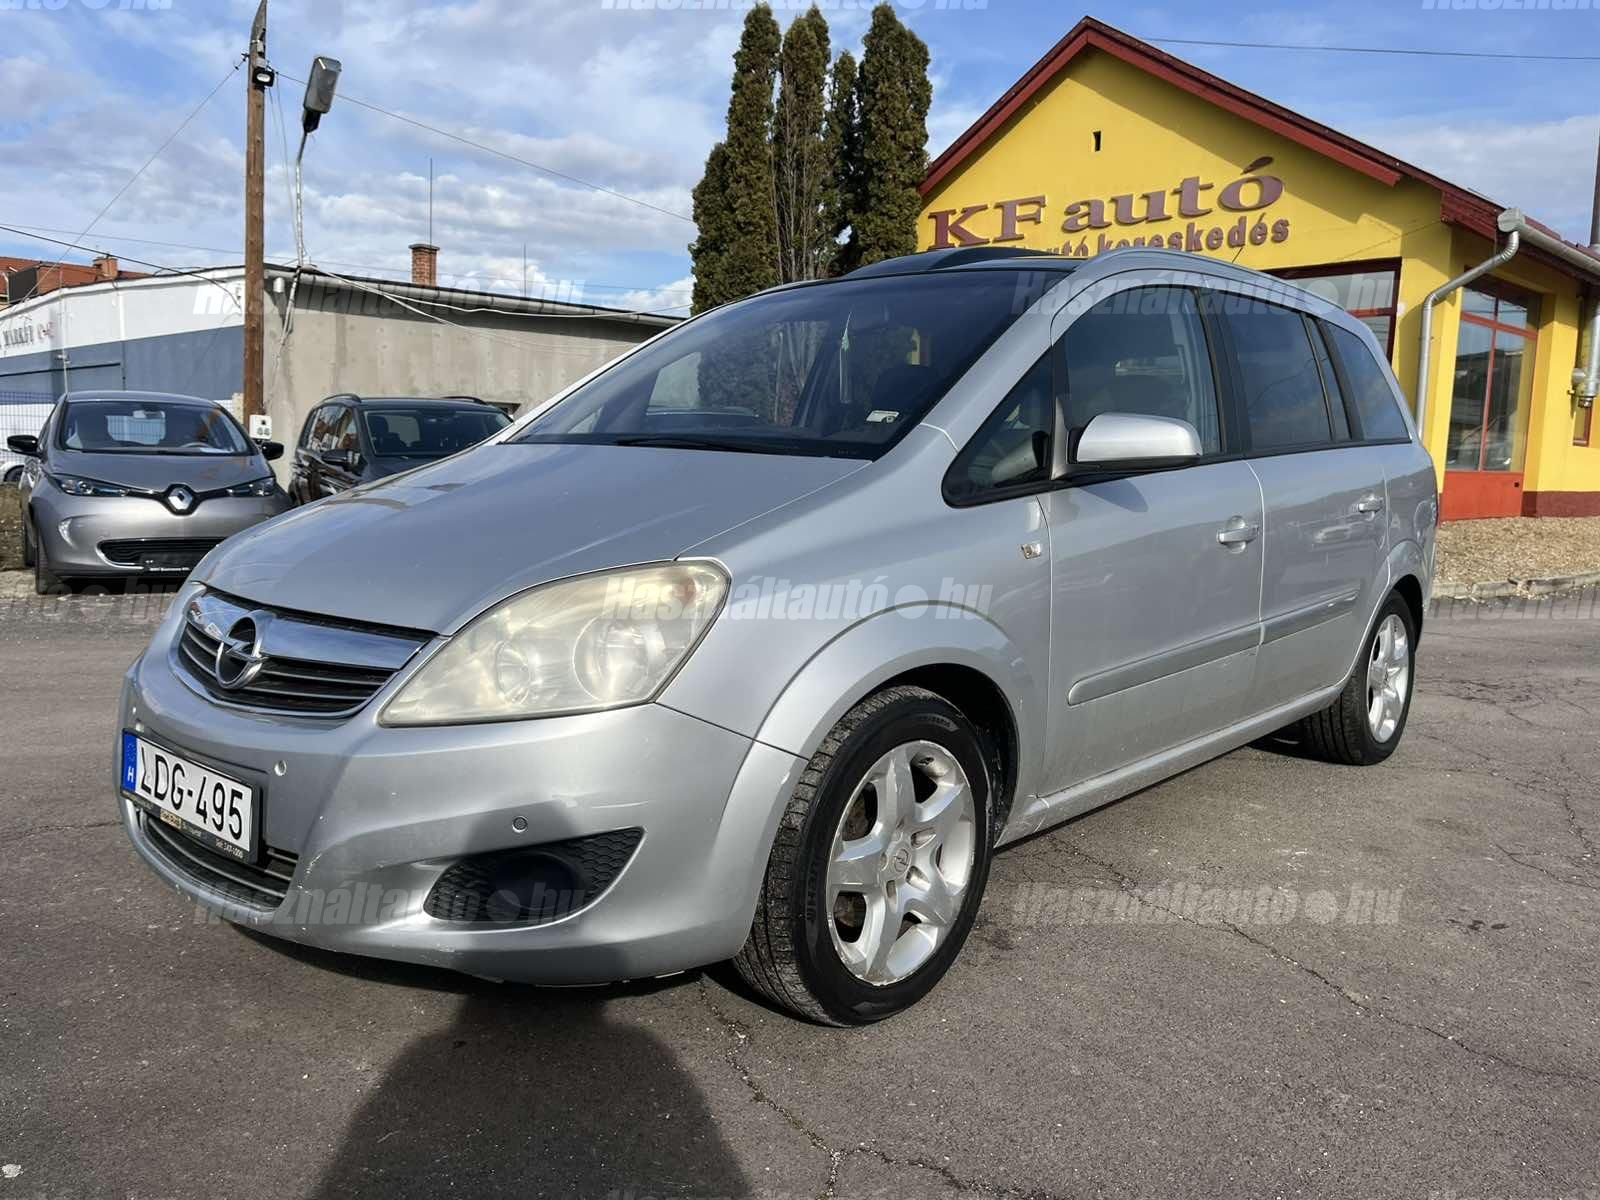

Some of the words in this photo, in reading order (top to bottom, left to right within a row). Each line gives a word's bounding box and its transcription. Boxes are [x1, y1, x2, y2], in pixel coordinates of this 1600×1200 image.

[928, 195, 1046, 250] KF
[1062, 156, 1285, 233] autó
[128, 766, 135, 784] H
[140, 746, 243, 840] LDG-495
